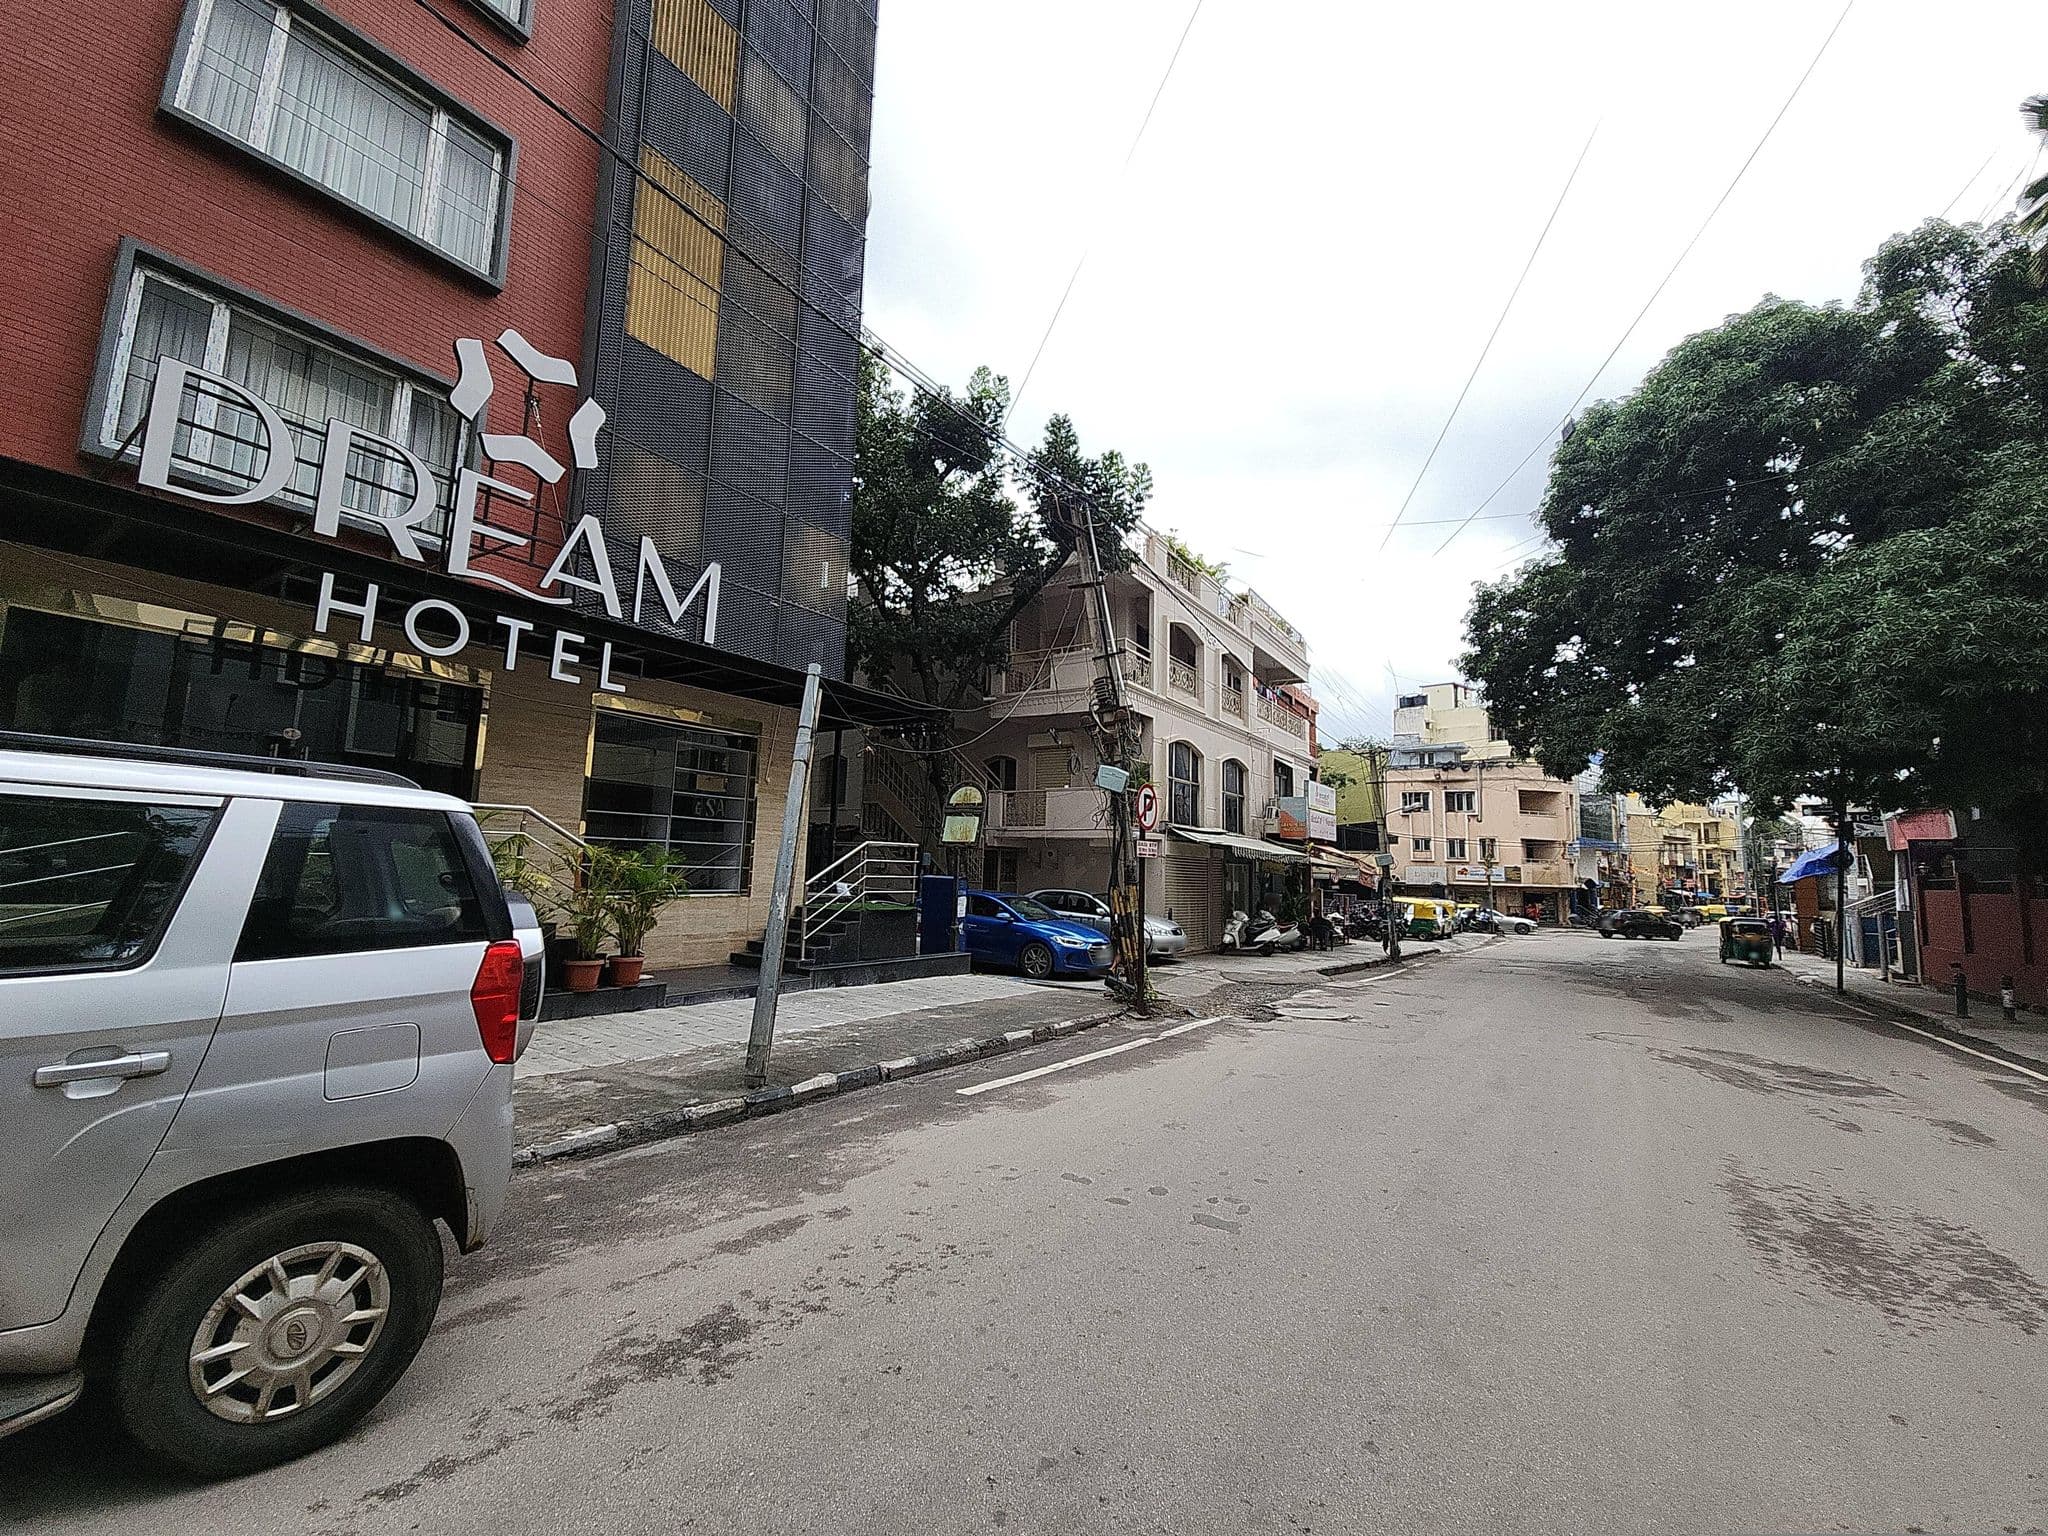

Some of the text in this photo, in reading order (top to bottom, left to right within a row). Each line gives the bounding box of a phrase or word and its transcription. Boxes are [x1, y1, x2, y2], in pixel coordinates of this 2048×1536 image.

[137, 355, 721, 646] DREAM
[314, 572, 627, 693] HOTEL
[1143, 794, 1154, 822] P
